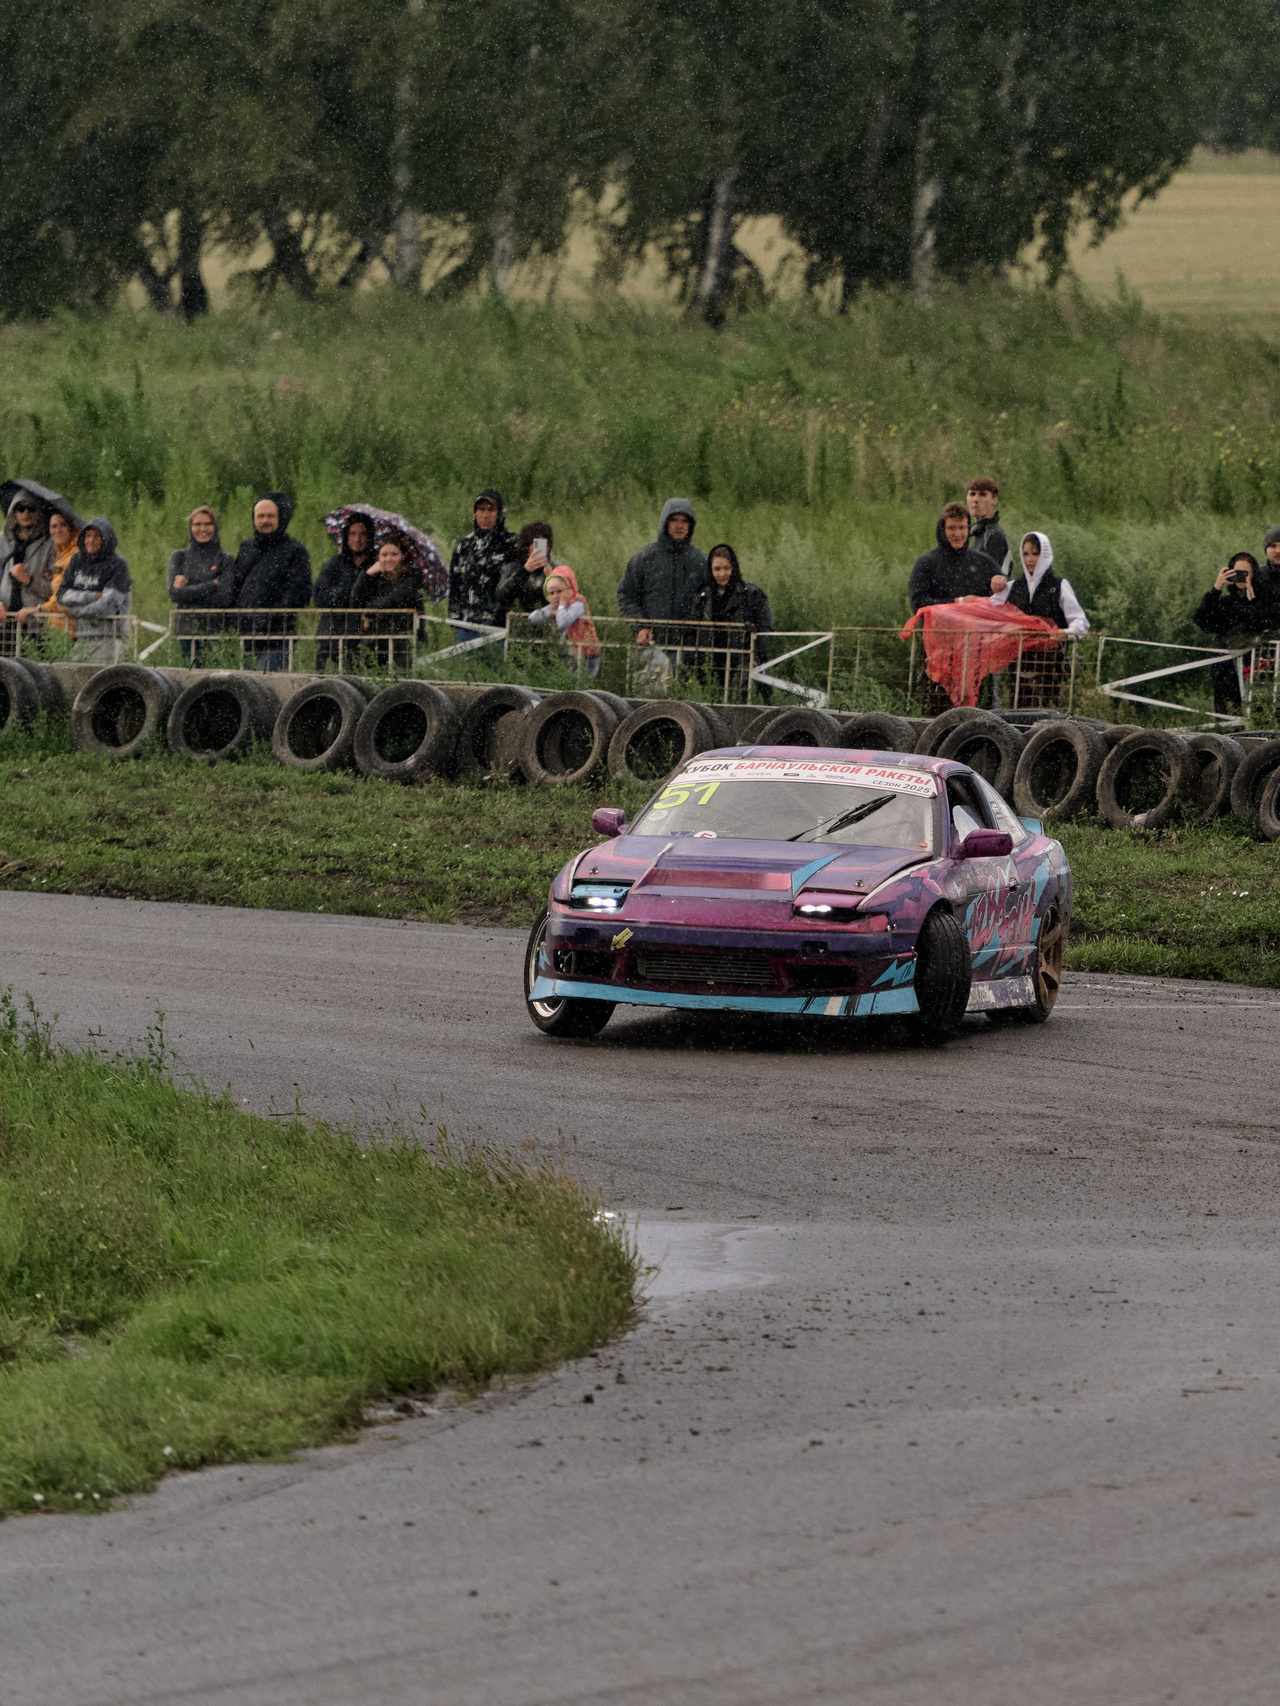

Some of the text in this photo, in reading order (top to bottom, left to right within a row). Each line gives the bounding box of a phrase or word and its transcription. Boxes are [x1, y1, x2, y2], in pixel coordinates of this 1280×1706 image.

[734, 762, 862, 775] БАРНАУЛЬСКОЙ
[865, 768, 932, 786] РАКЕТЫ
[872, 779, 931, 793] СЕЗОН 2025
[653, 782, 720, 809] 51
